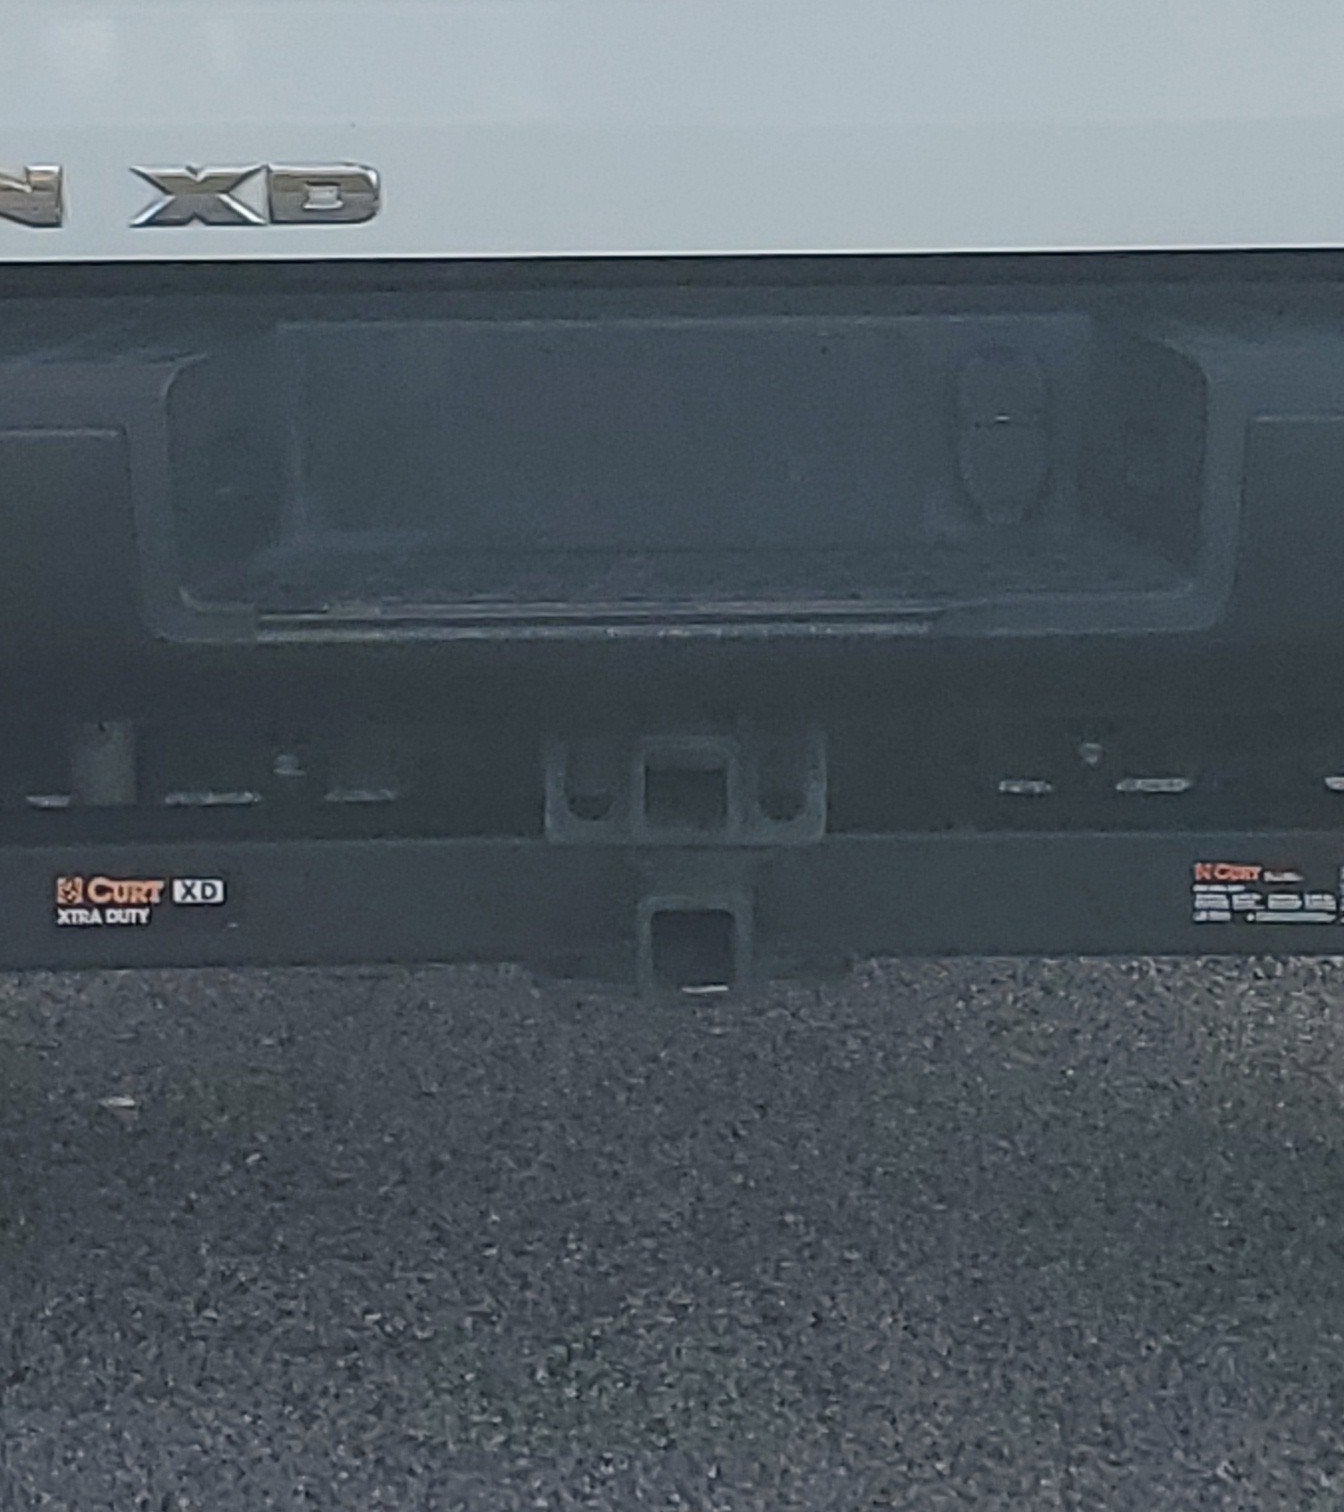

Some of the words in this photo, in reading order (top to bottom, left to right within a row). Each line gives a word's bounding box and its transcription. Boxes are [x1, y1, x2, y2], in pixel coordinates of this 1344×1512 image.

[127, 161, 383, 228] XD
[87, 876, 164, 904] CURT
[180, 881, 218, 901] XD
[56, 908, 103, 926] XTRA
[105, 907, 151, 925] DUTY
